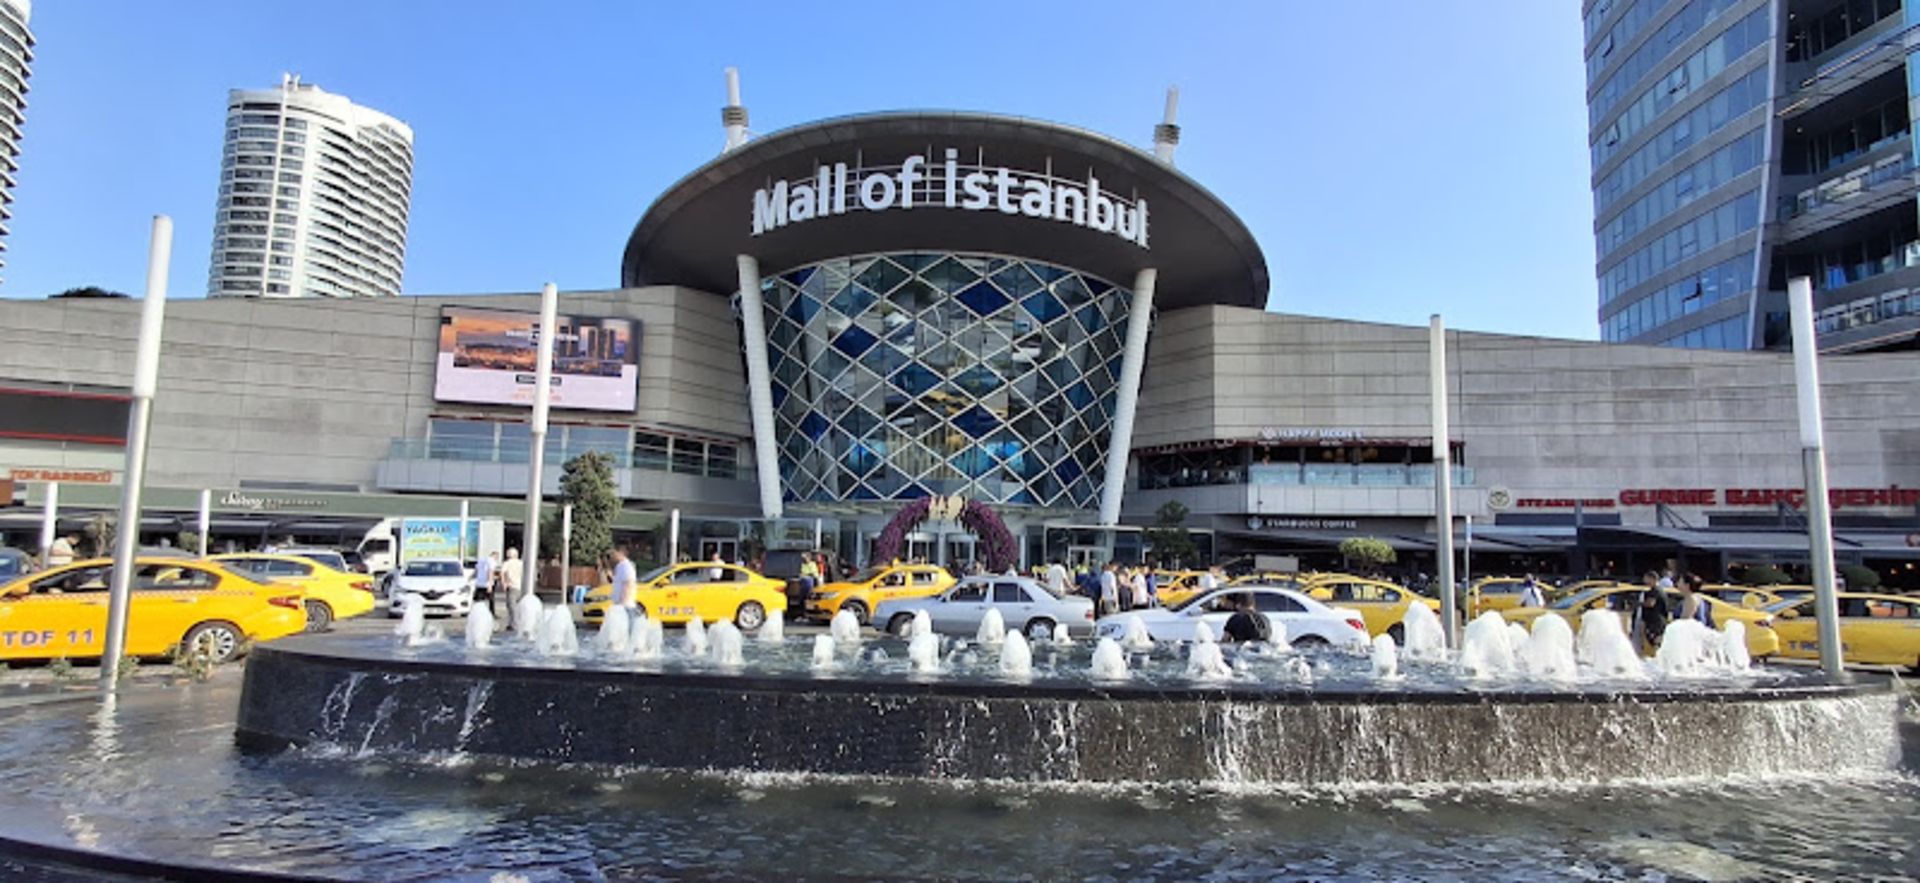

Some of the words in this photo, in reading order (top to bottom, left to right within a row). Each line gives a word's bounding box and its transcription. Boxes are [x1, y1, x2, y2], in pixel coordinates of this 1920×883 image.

[751, 162, 847, 236] Mall
[860, 155, 925, 211] of
[1619, 489, 1716, 505] GURME
[1267, 519, 1320, 529] STARBUCKS
[1322, 519, 1357, 529] COFFEE
[3, 630, 55, 646] TDF
[67, 627, 93, 644] 11
